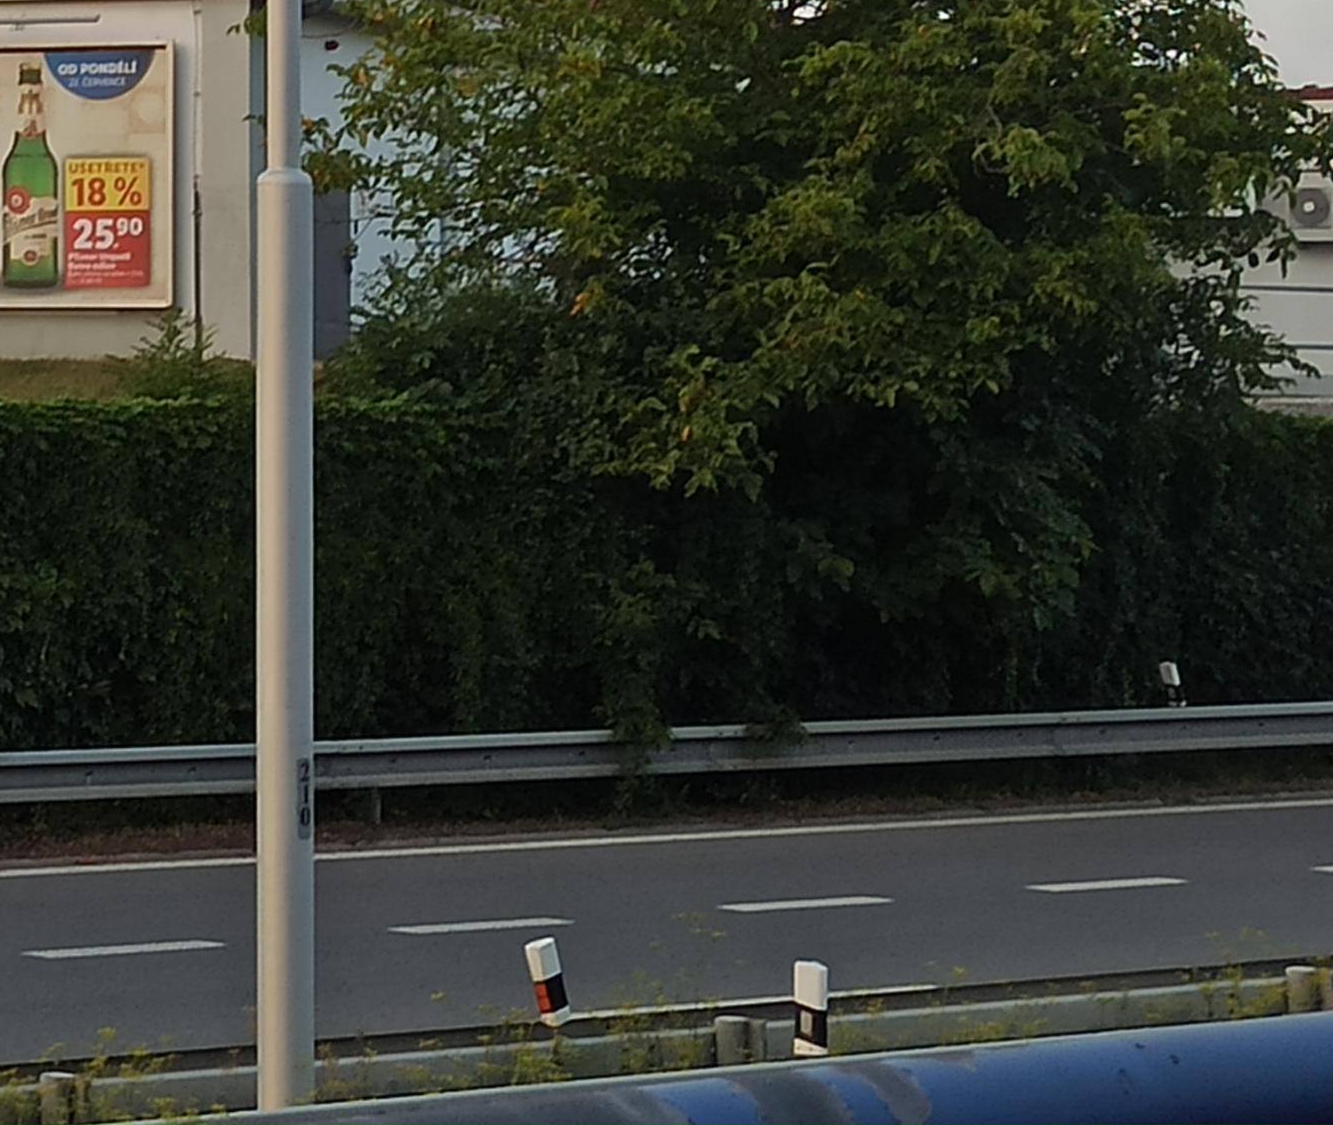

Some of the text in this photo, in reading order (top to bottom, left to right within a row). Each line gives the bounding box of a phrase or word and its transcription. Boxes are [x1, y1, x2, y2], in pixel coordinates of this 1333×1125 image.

[71, 176, 142, 206] 18 %
[299, 762, 310, 825] 210
